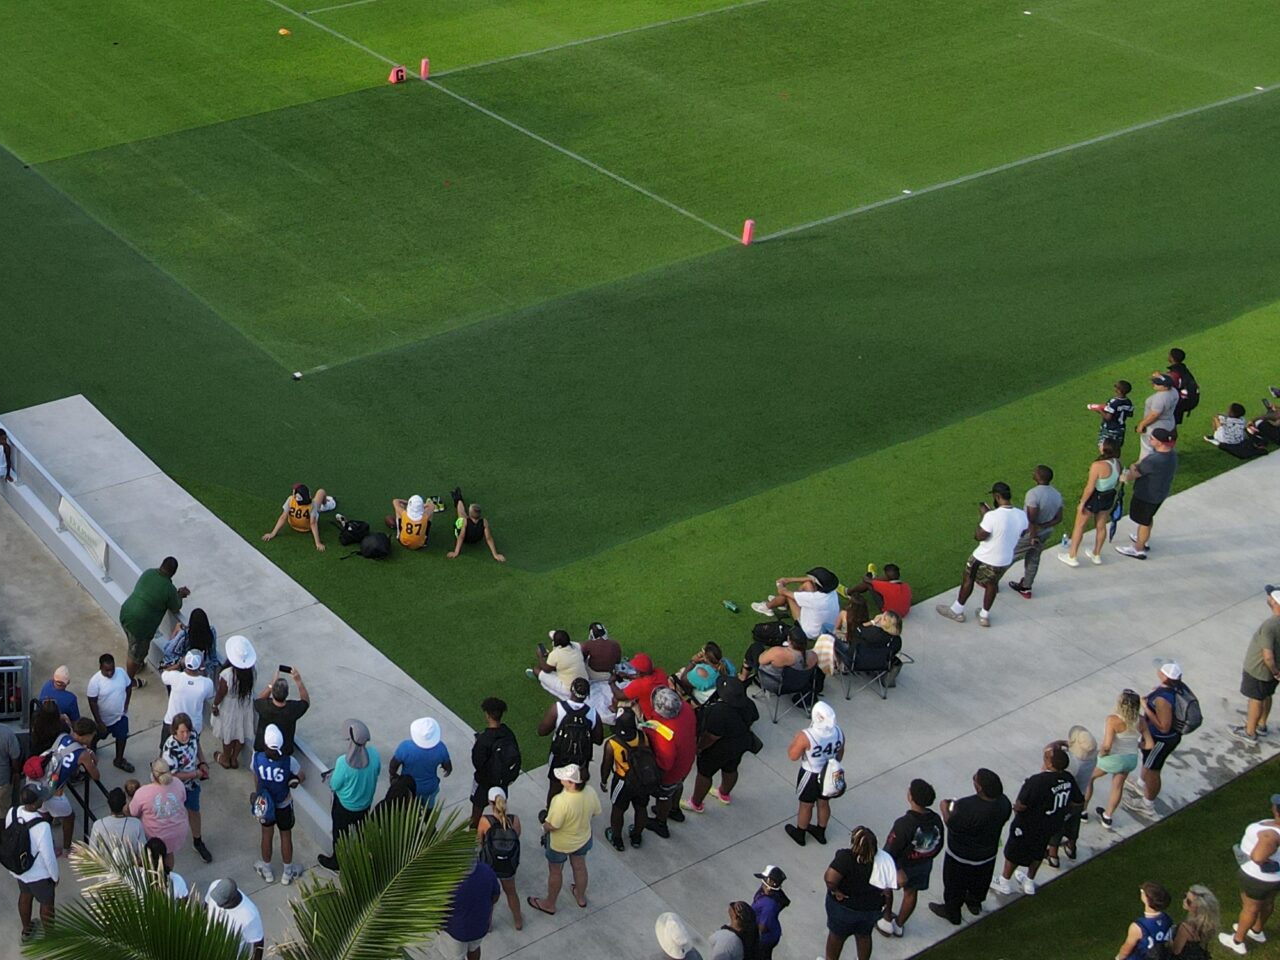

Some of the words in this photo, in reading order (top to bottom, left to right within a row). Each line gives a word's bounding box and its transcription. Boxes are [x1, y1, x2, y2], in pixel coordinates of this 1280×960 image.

[288, 506, 310, 520] 284
[405, 522, 422, 536] 87
[811, 740, 842, 758] 242
[258, 764, 284, 782] 116
